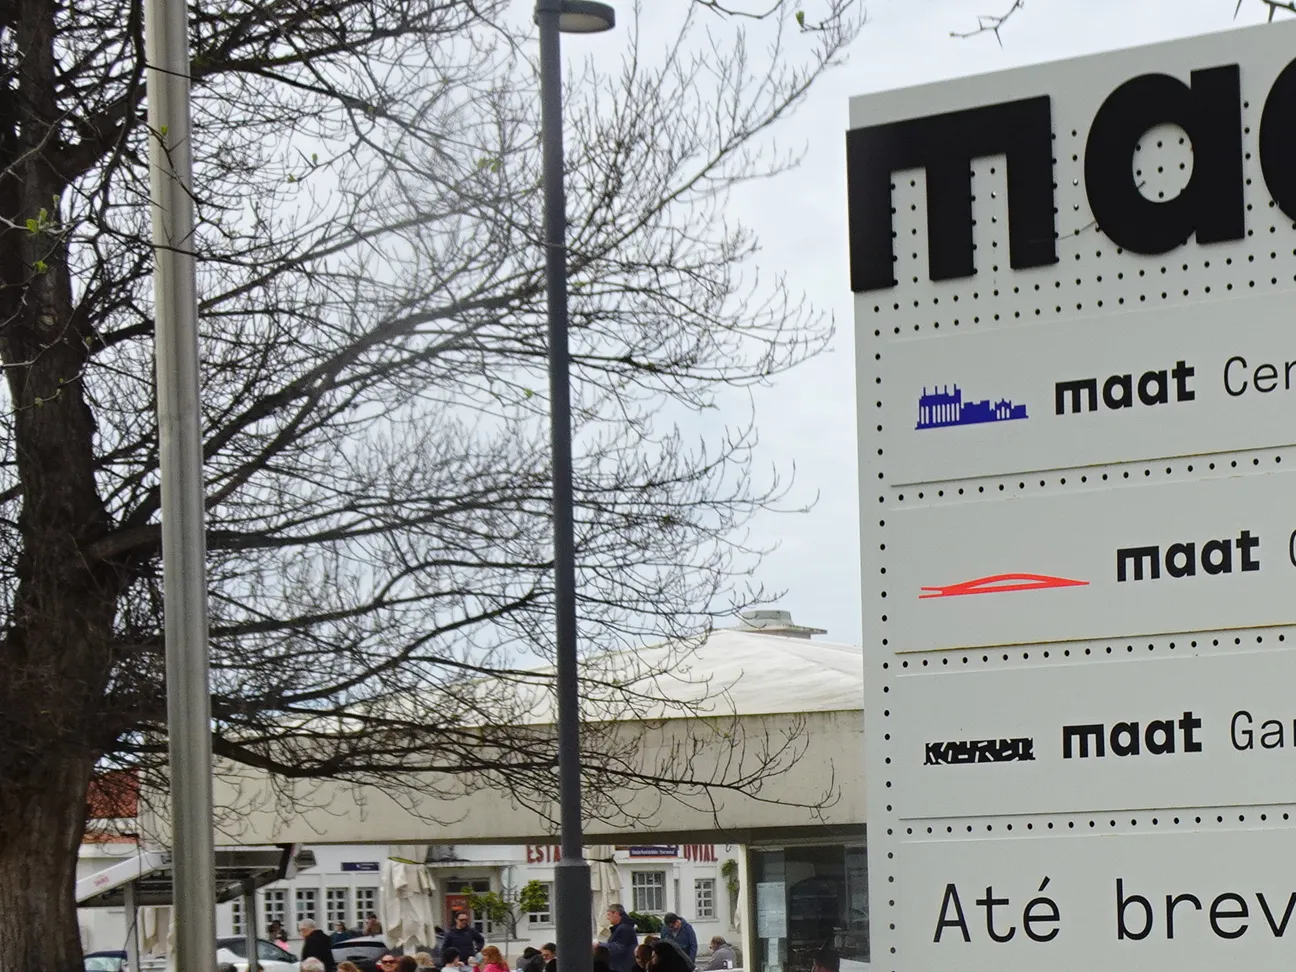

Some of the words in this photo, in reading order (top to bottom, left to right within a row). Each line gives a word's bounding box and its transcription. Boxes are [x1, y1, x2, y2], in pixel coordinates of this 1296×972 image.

[1055, 360, 1196, 415] maat
[1117, 530, 1260, 582] maat
[1062, 711, 1202, 759] maat
[932, 876, 1062, 944] Até
